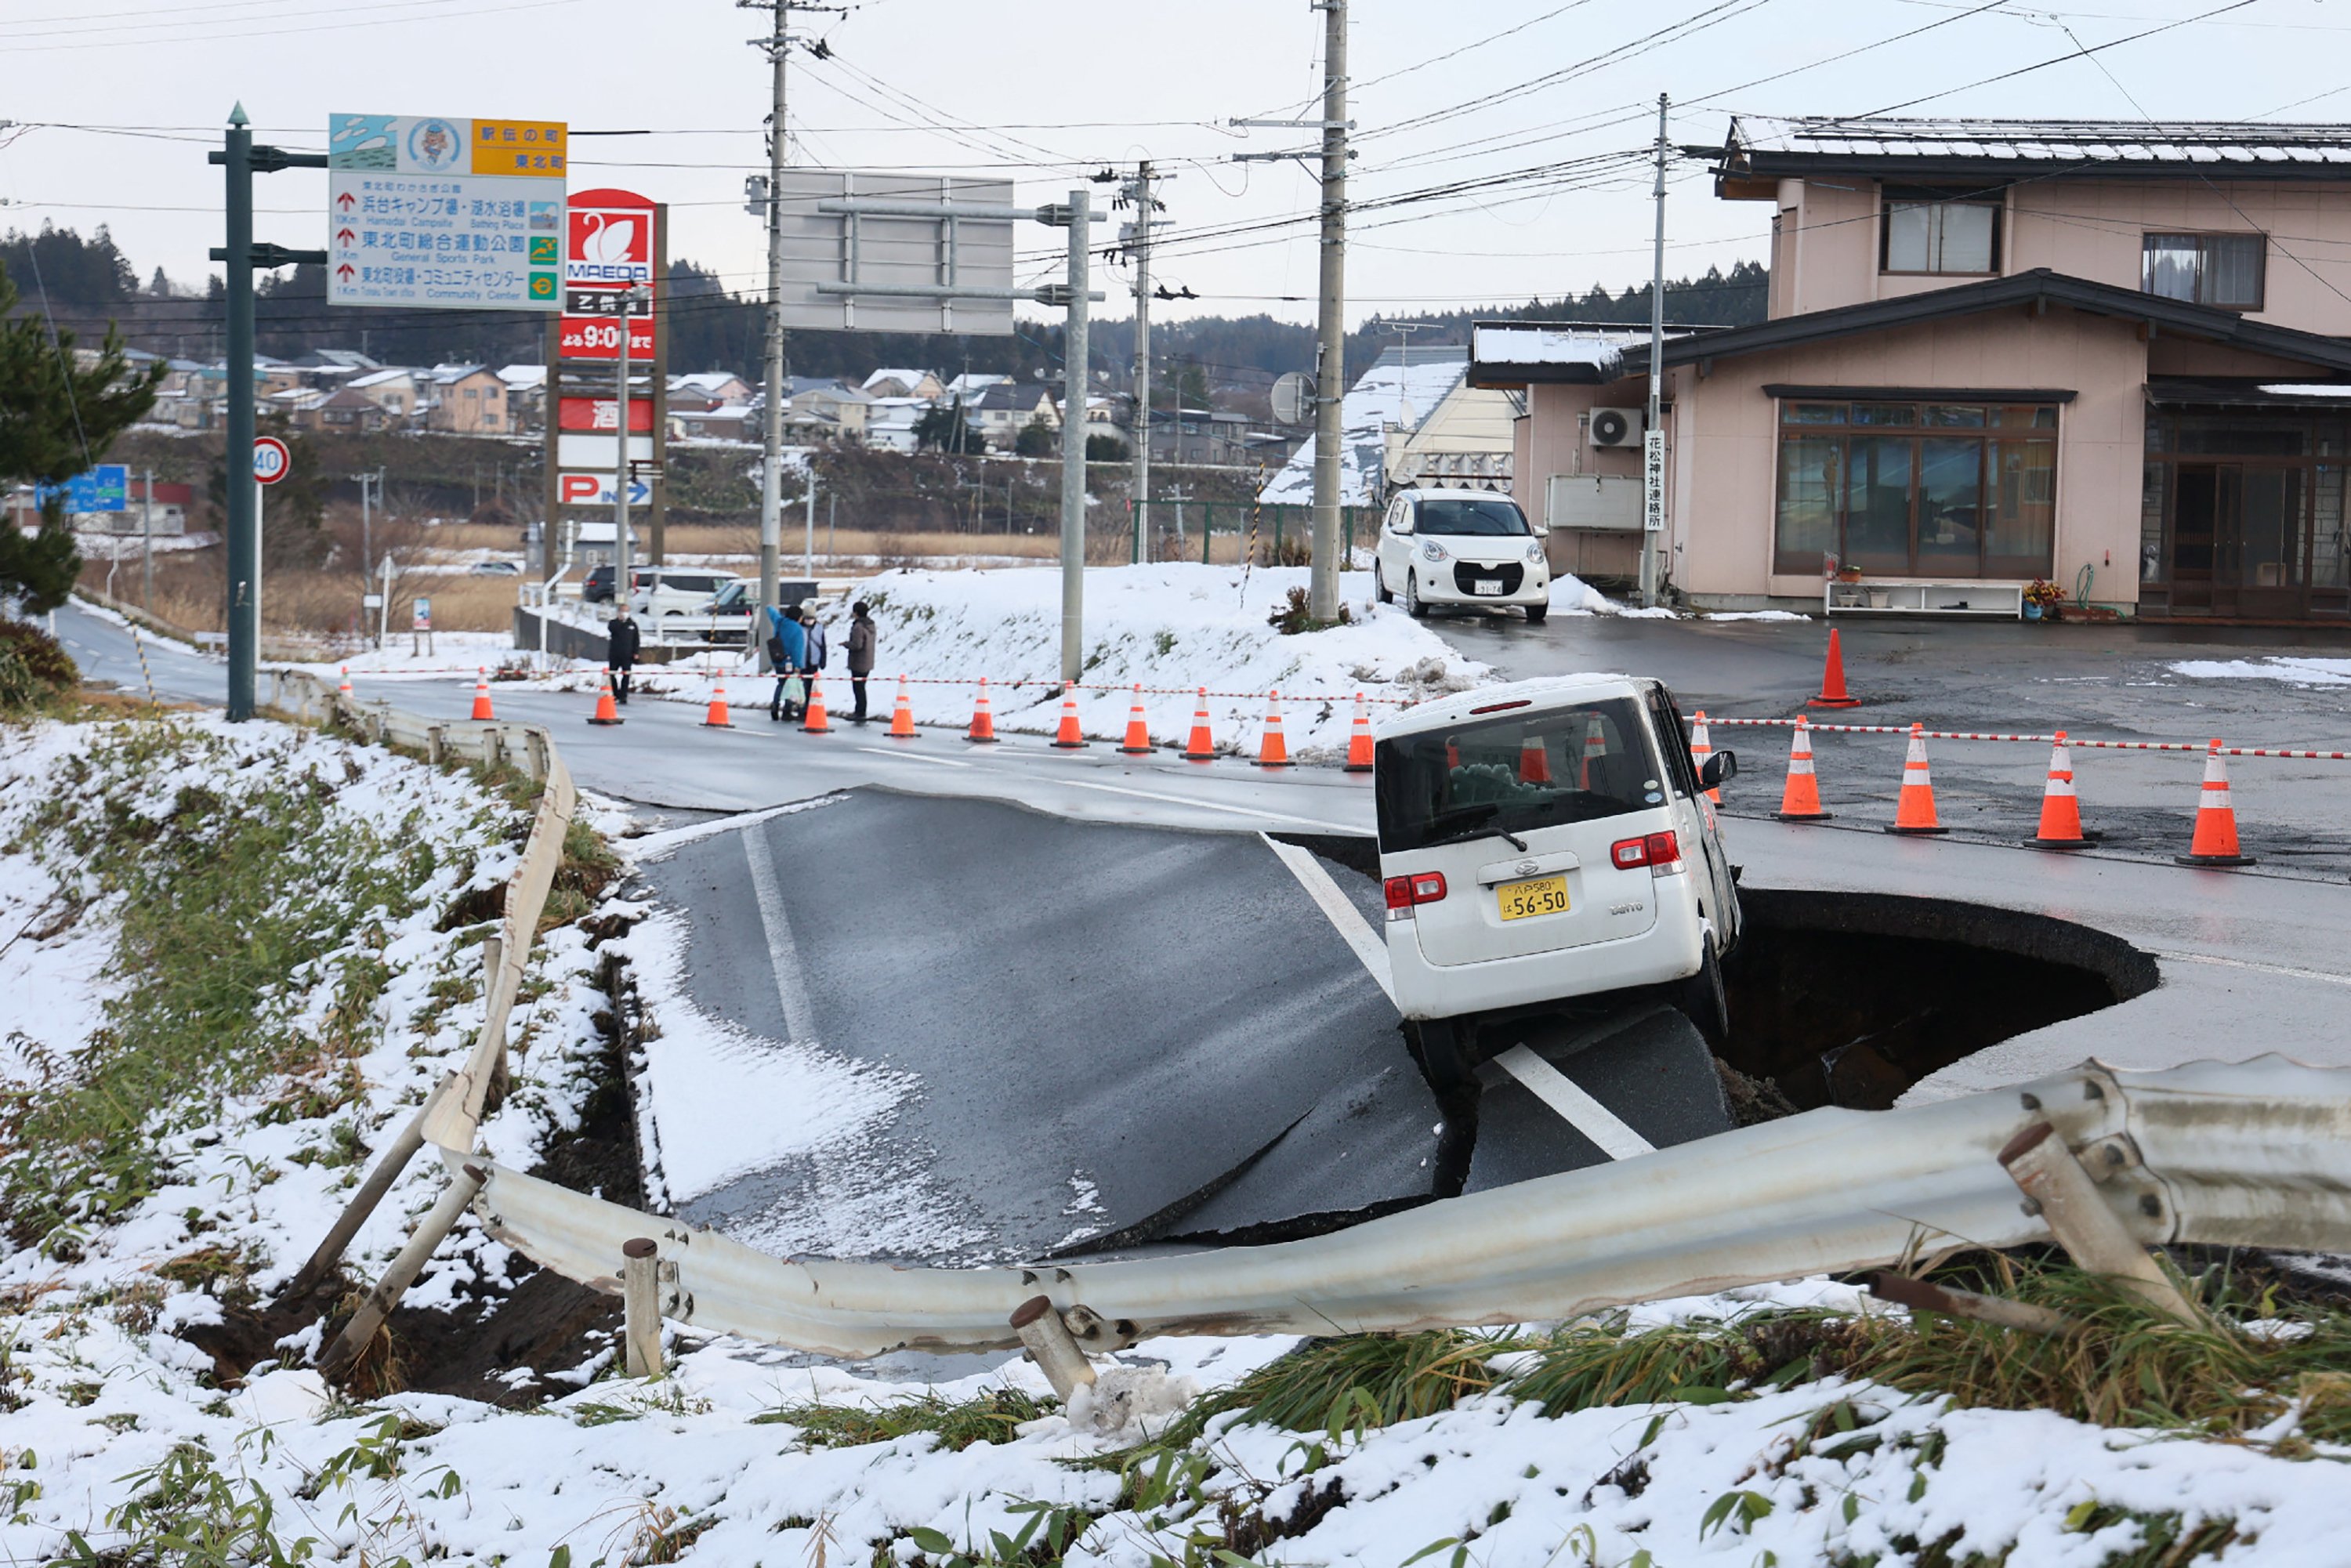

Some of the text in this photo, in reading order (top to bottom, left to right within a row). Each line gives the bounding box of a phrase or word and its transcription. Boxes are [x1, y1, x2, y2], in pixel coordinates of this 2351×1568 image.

[481, 126, 559, 143] 駅伝の町
[514, 154, 564, 168] 東北町
[502, 220, 524, 230] Place
[361, 230, 525, 253] 東北町総合運動公園
[390, 252, 496, 264] General Sports Park
[567, 264, 647, 280] MAEDA
[426, 288, 481, 300] Community
[487, 290, 521, 300] Center
[592, 400, 620, 429] 酒
[252, 451, 280, 470] 40
[563, 476, 600, 502] P
[1649, 437, 1661, 526] 花松神社連絡所
[1513, 890, 1566, 915] 56-50
